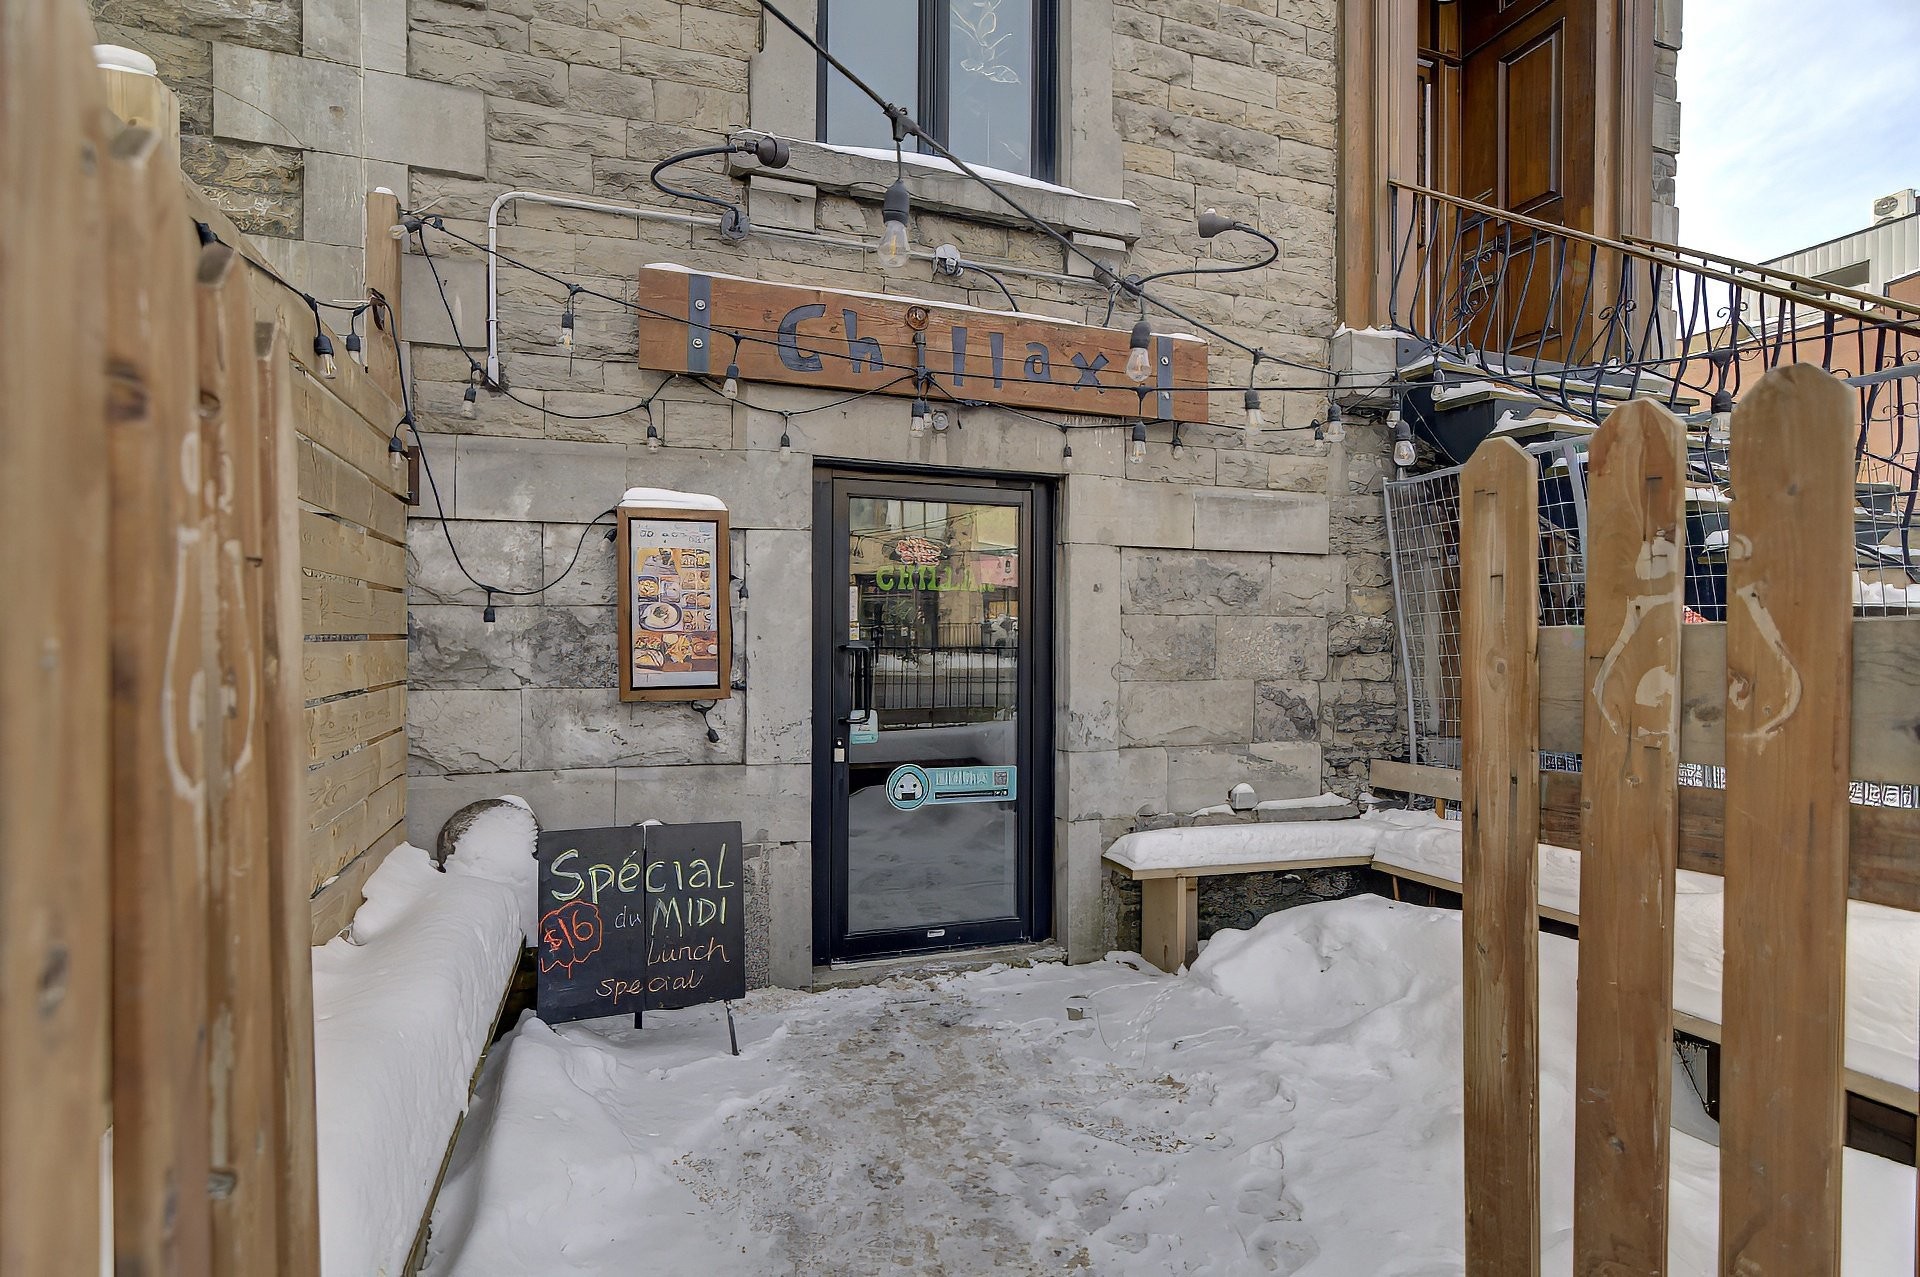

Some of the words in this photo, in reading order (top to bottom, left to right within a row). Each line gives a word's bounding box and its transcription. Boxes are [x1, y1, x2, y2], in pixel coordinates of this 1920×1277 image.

[543, 909, 594, 953] $16
[614, 905, 643, 929] du
[651, 896, 727, 938] MIDI
[647, 936, 731, 967] Lunch
[595, 969, 704, 1005] special
